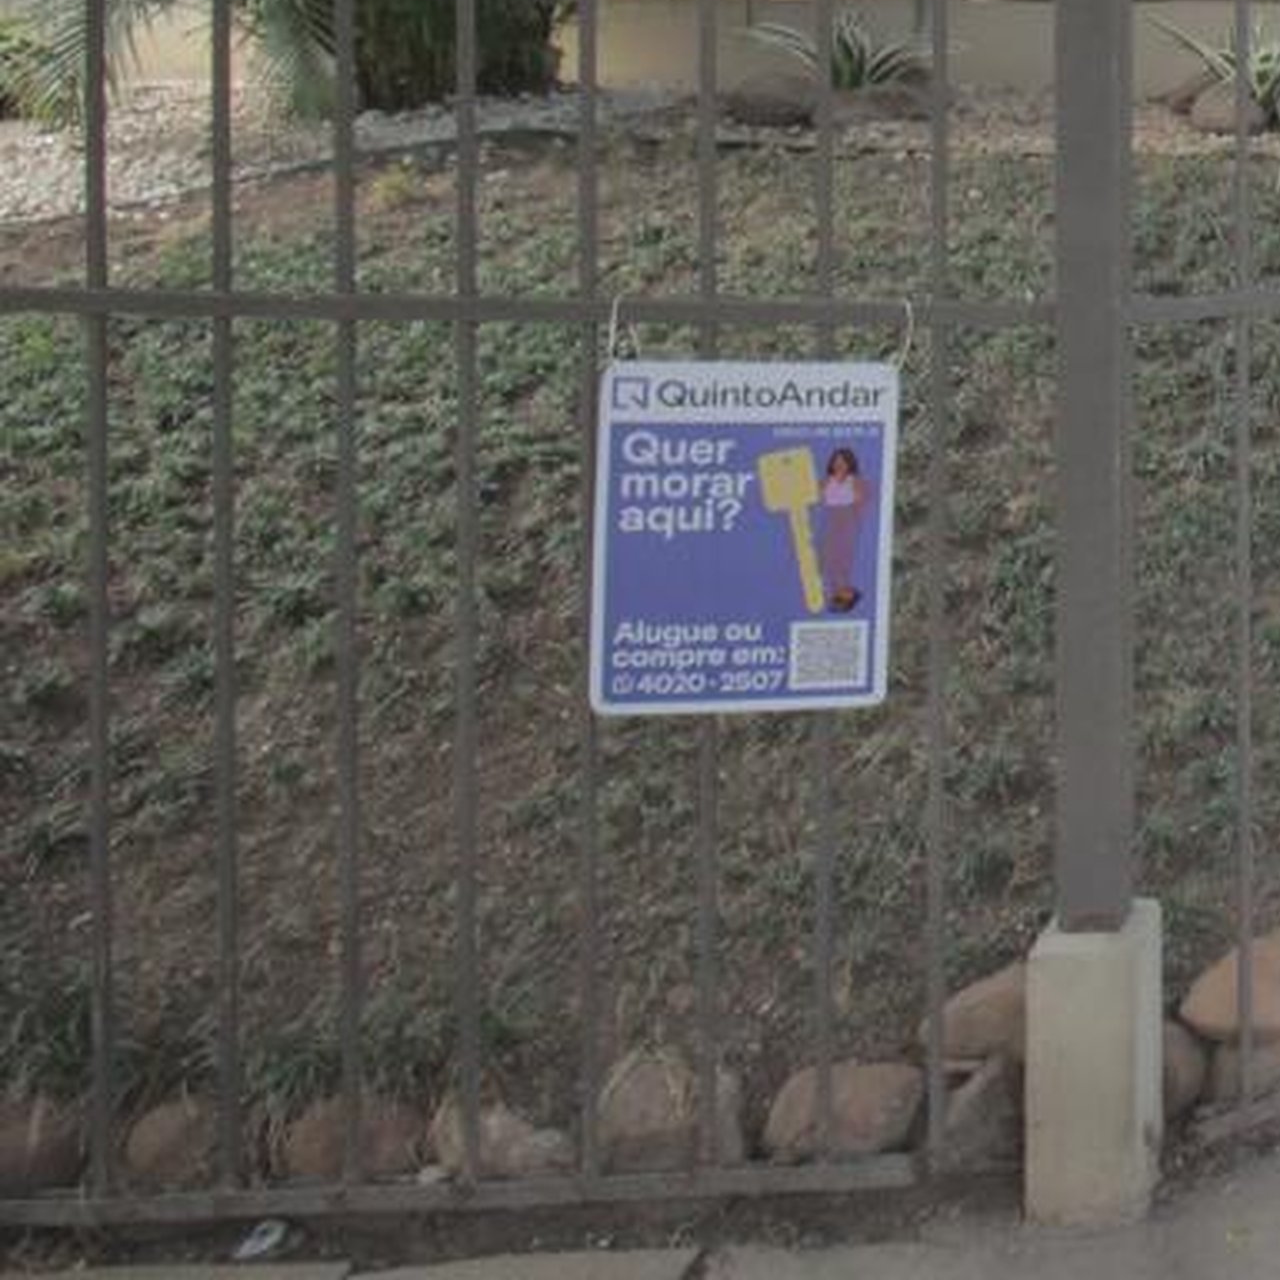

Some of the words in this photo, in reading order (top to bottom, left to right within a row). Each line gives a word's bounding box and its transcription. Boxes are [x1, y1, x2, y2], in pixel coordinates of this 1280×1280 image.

[656, 380, 885, 409] QuintoAndar
[621, 431, 736, 466] Quer
[619, 471, 754, 499] morar
[618, 497, 743, 539] aqui?
[613, 620, 718, 648] Alugue
[725, 622, 762, 642] ou
[732, 645, 787, 665] em:
